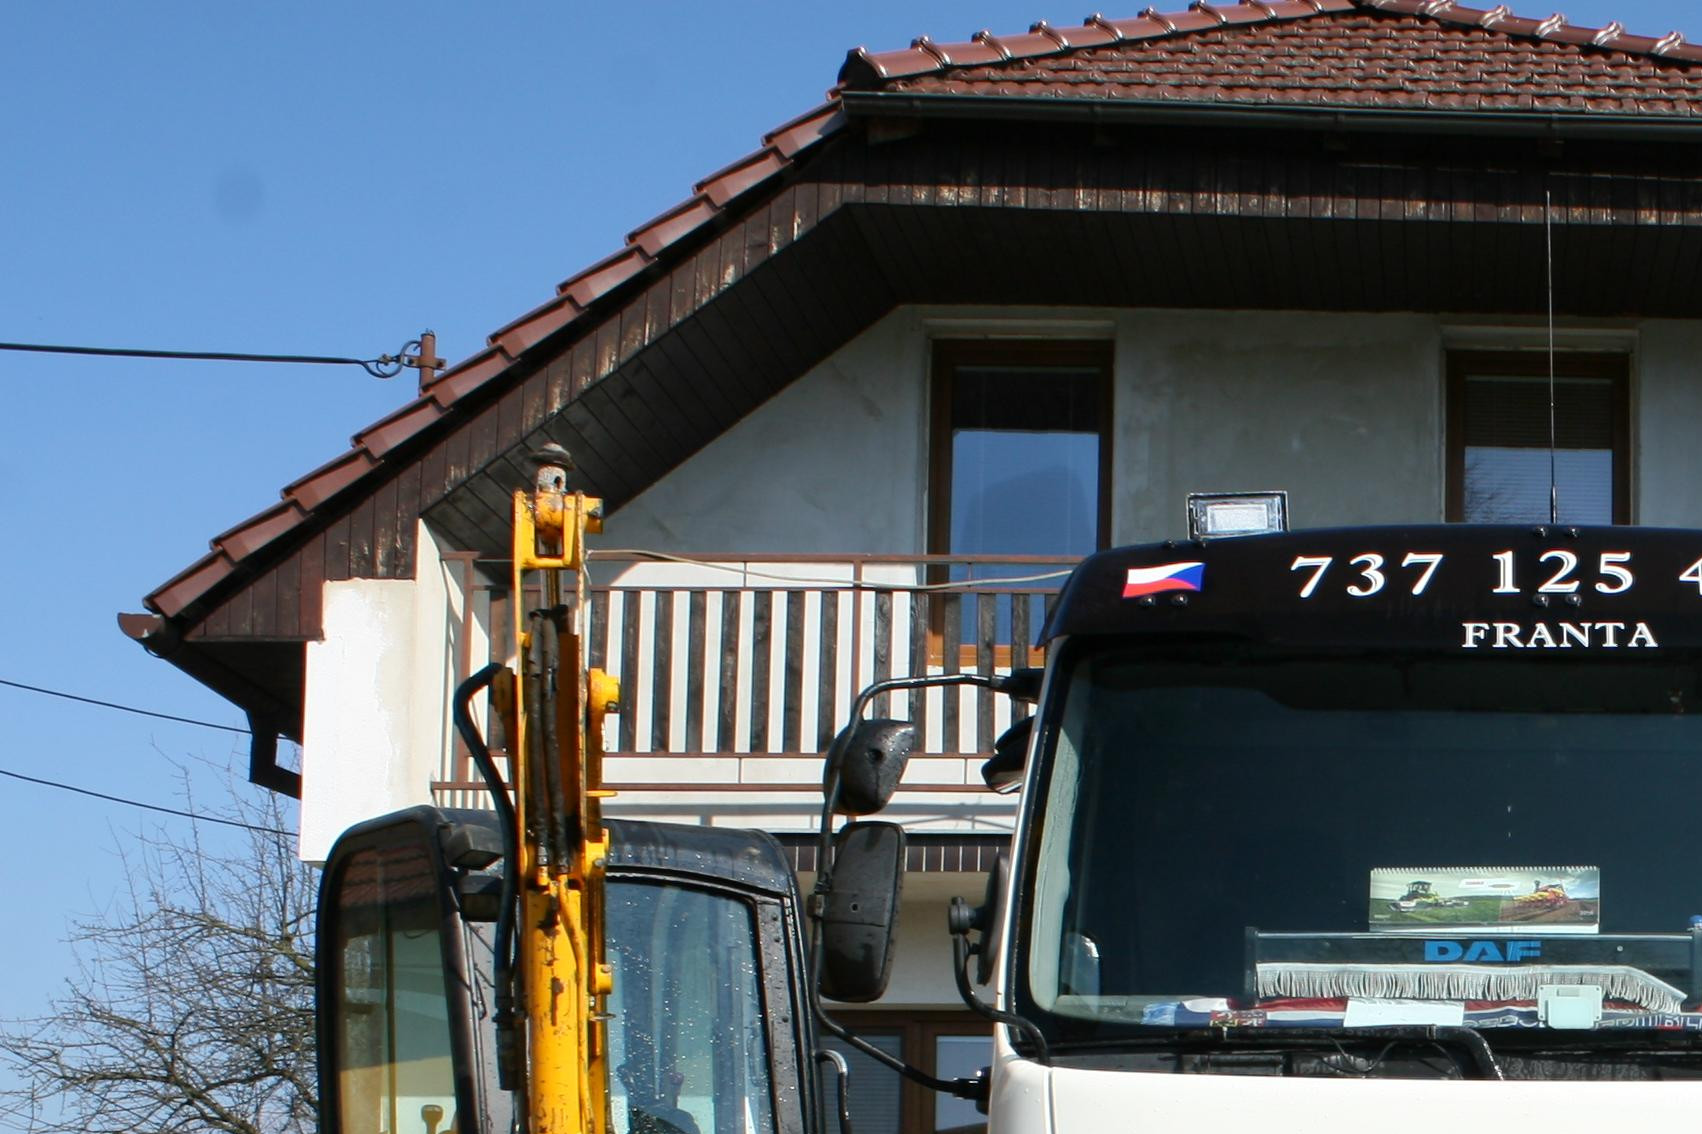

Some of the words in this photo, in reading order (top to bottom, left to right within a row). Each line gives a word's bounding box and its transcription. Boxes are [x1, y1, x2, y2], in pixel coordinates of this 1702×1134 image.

[1289, 552, 1444, 598] 737
[1492, 550, 1634, 594] 125
[1461, 622, 1659, 648] FRANTA
[1423, 938, 1543, 963] DAF
